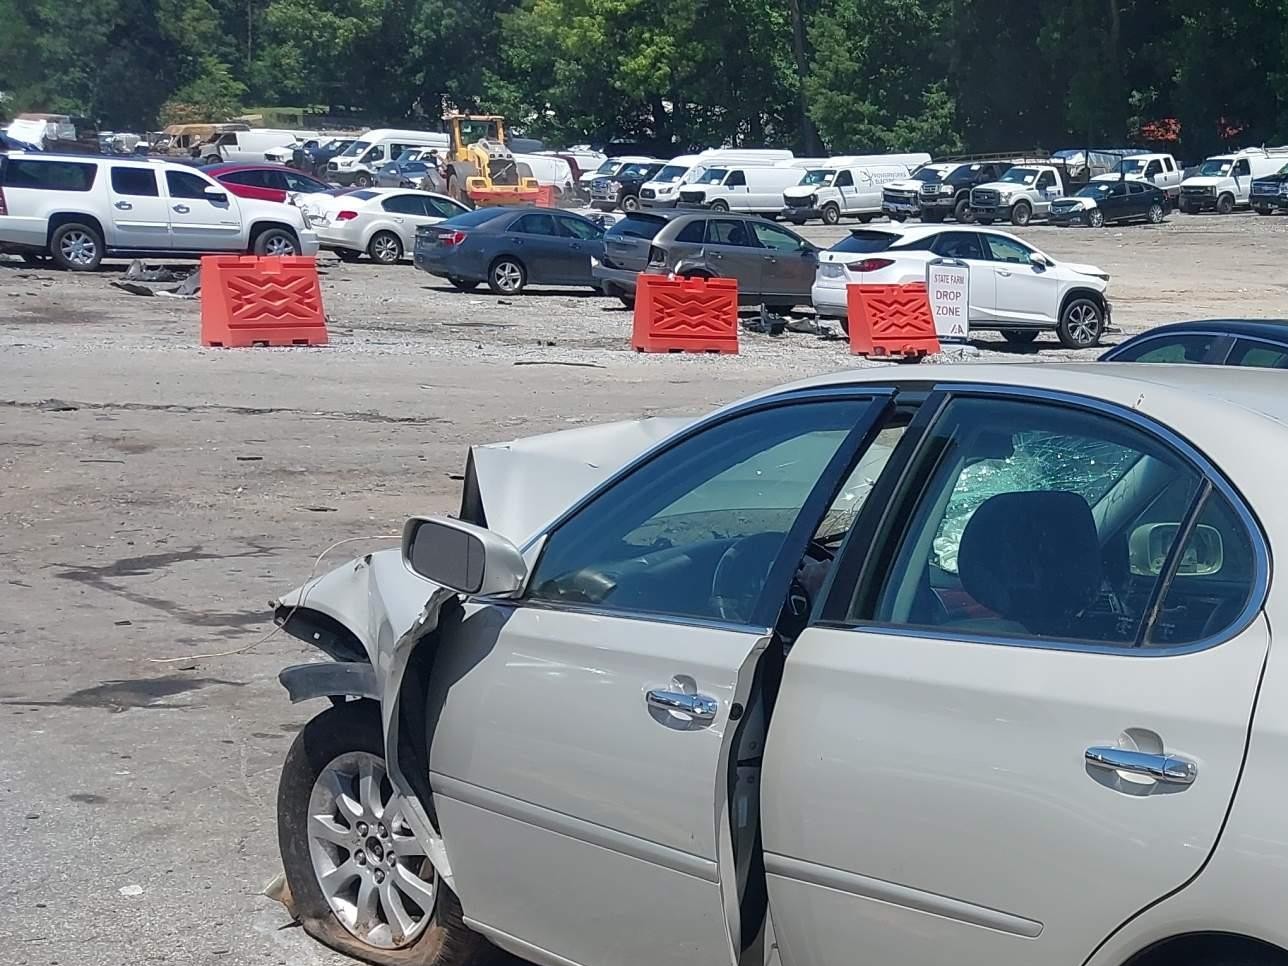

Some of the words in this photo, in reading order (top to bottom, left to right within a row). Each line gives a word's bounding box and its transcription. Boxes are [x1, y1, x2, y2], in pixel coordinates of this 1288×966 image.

[934, 274, 950, 285] STATE
[951, 274, 965, 285] FARM
[936, 290, 961, 301] DROP
[936, 306, 960, 316] ZONE
